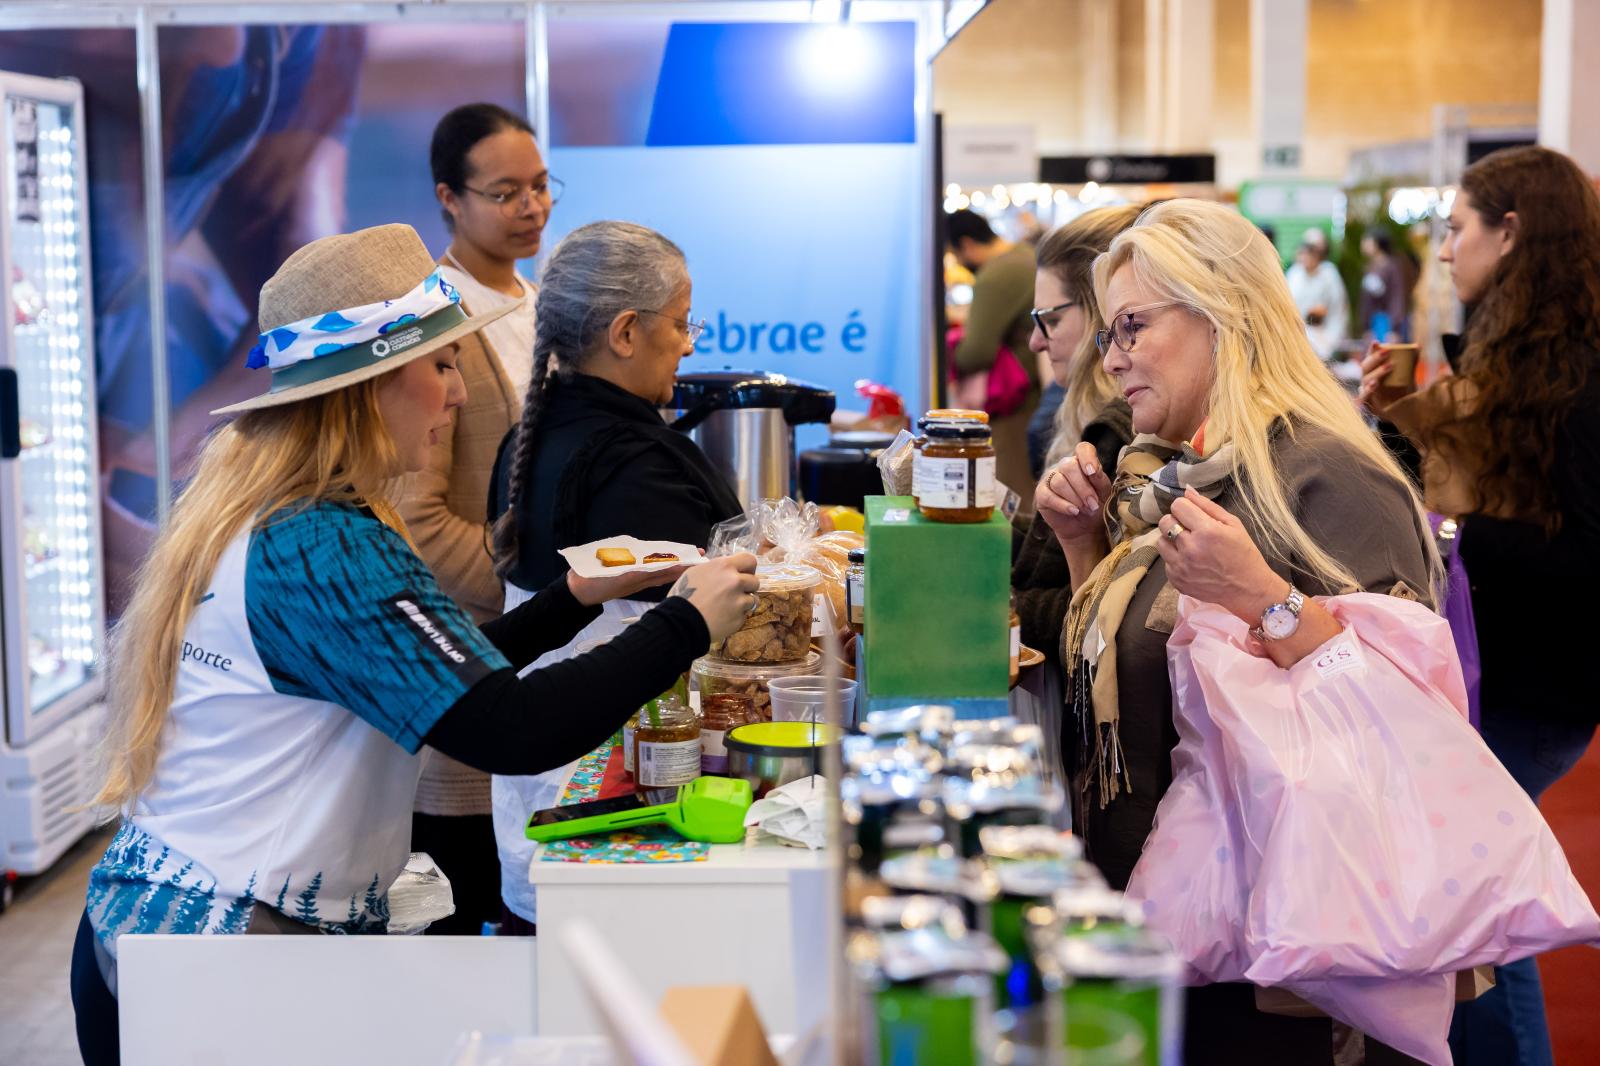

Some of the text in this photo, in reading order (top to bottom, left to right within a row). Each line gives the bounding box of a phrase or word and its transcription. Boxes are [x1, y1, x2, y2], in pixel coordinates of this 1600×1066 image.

[694, 309, 867, 353] ebrae é
[181, 640, 232, 671] porte
